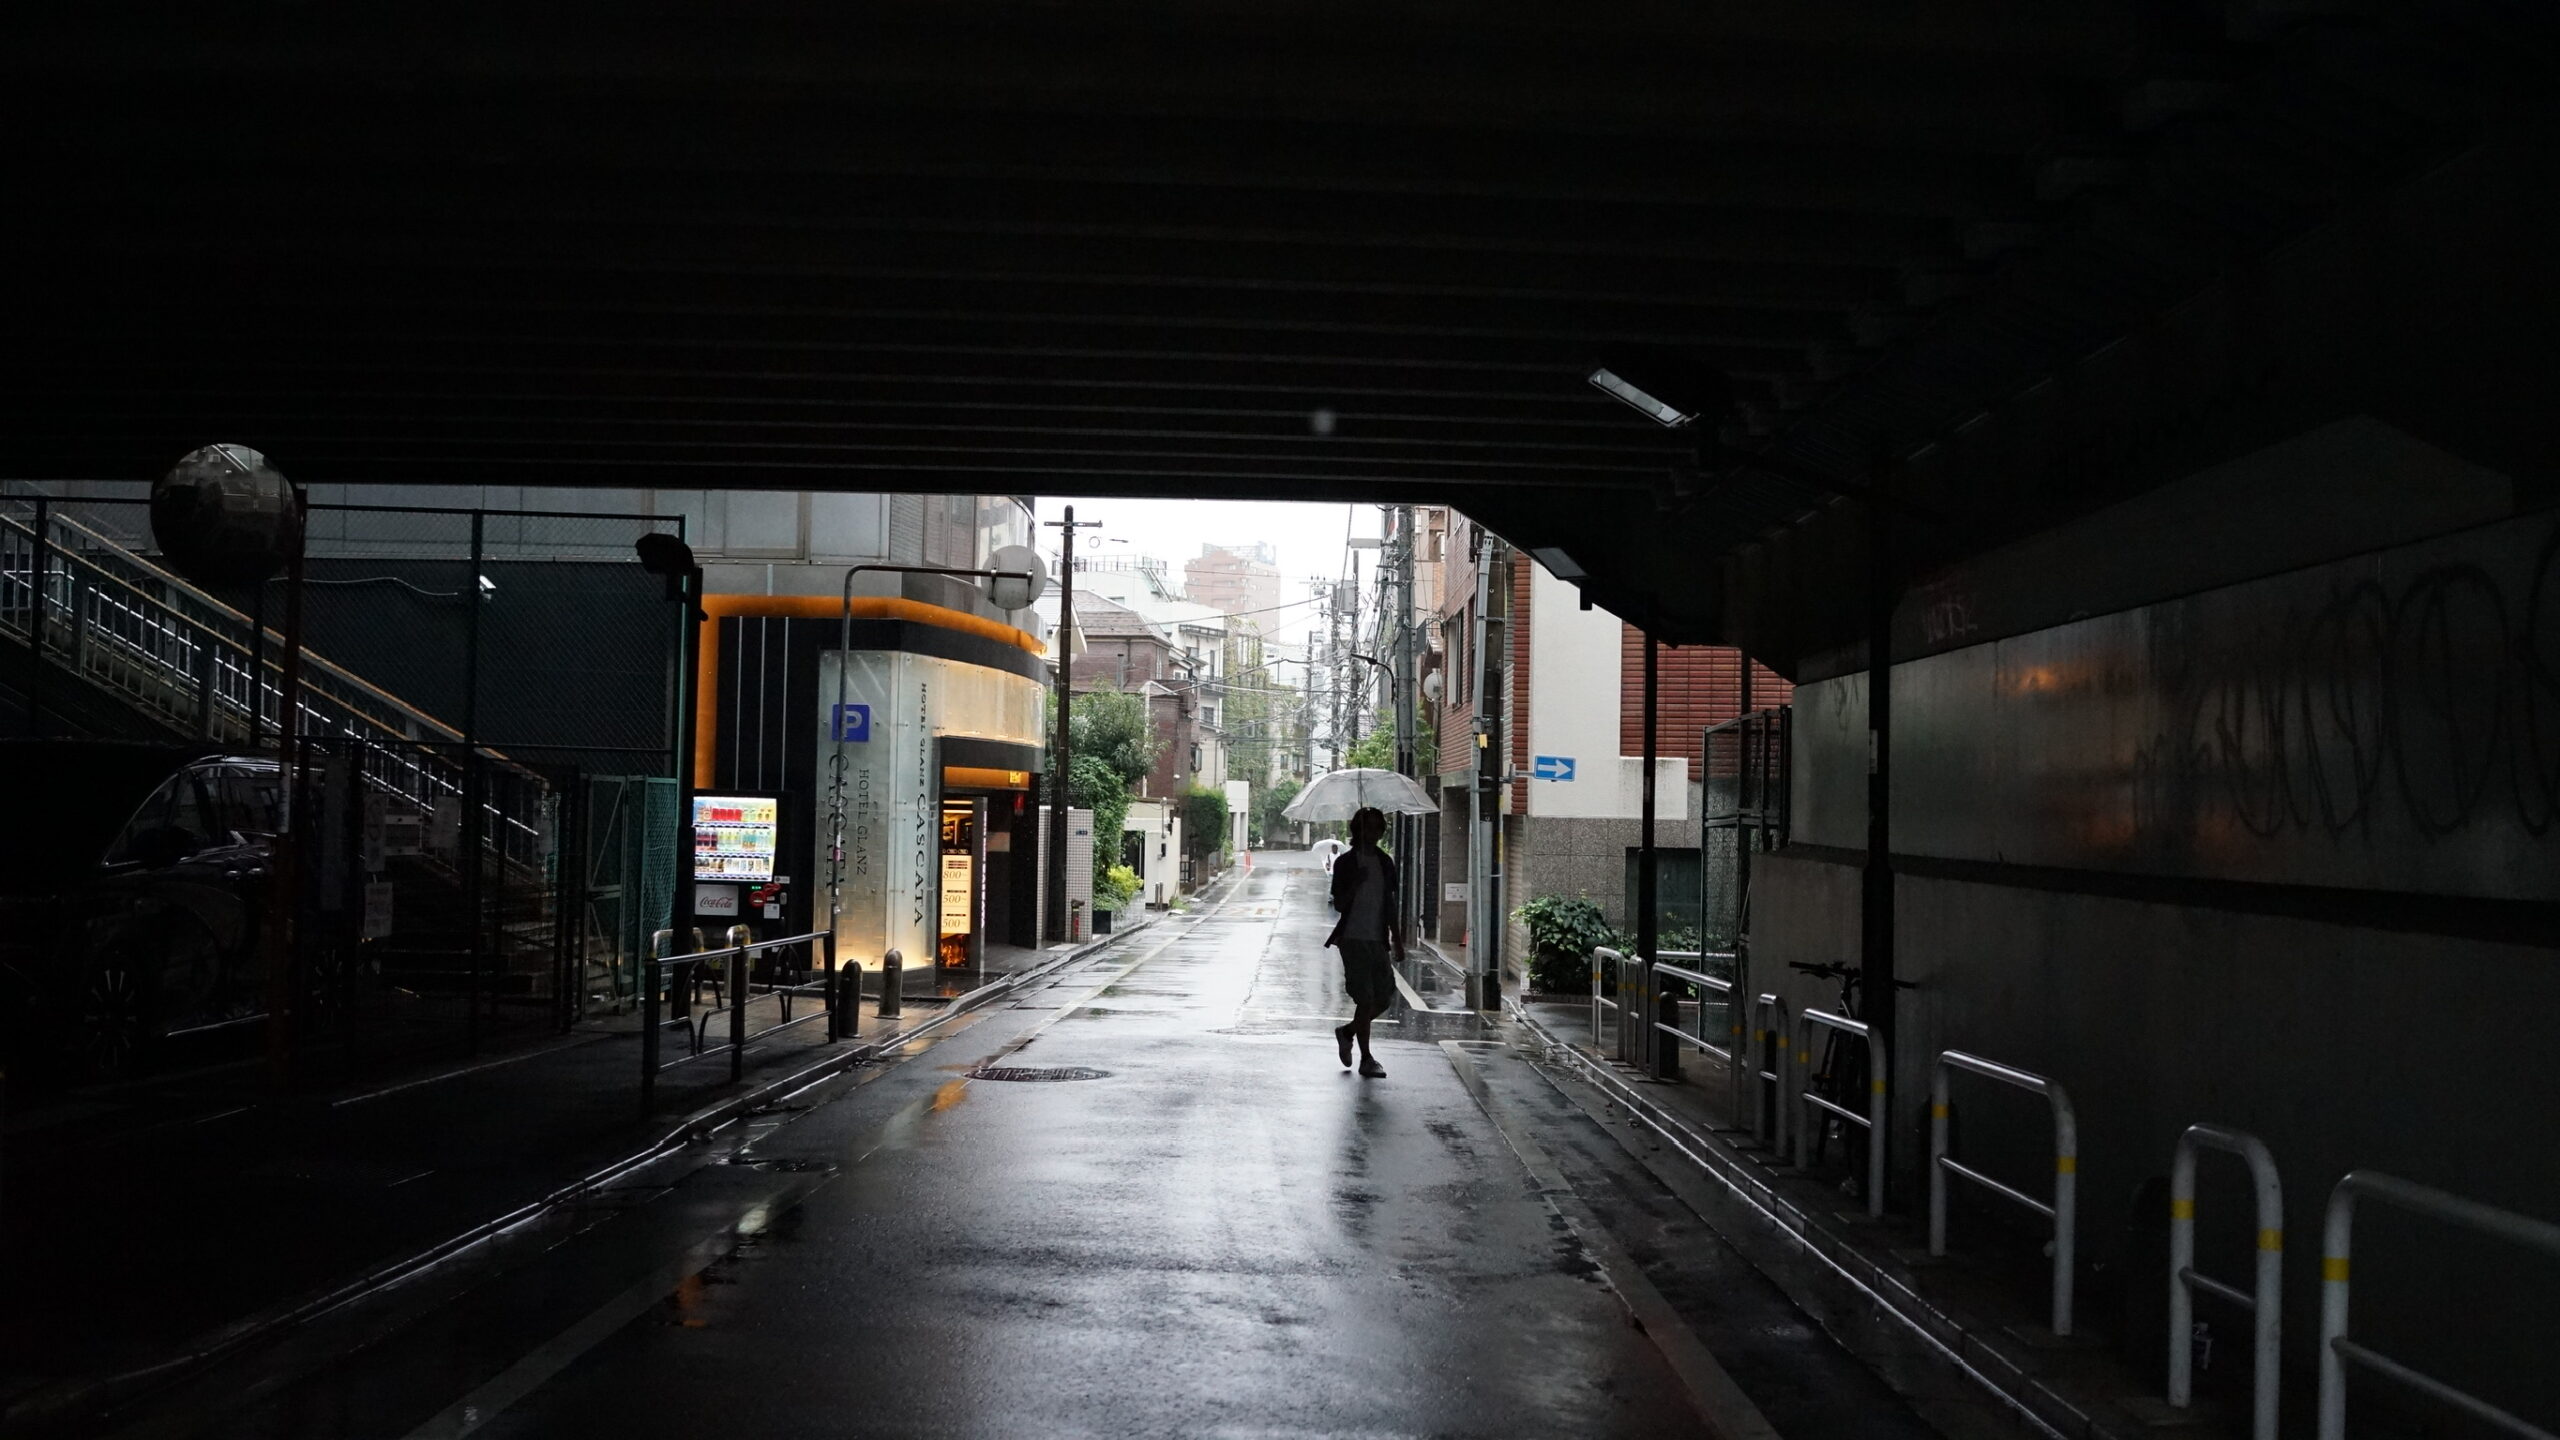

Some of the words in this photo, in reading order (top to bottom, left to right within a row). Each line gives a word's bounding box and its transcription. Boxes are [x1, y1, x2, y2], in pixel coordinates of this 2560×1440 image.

[841, 710, 863, 739] P
[858, 769, 869, 819] HOTEL
[856, 825, 868, 876] GLANZ
[914, 793, 926, 928] CASCATA
